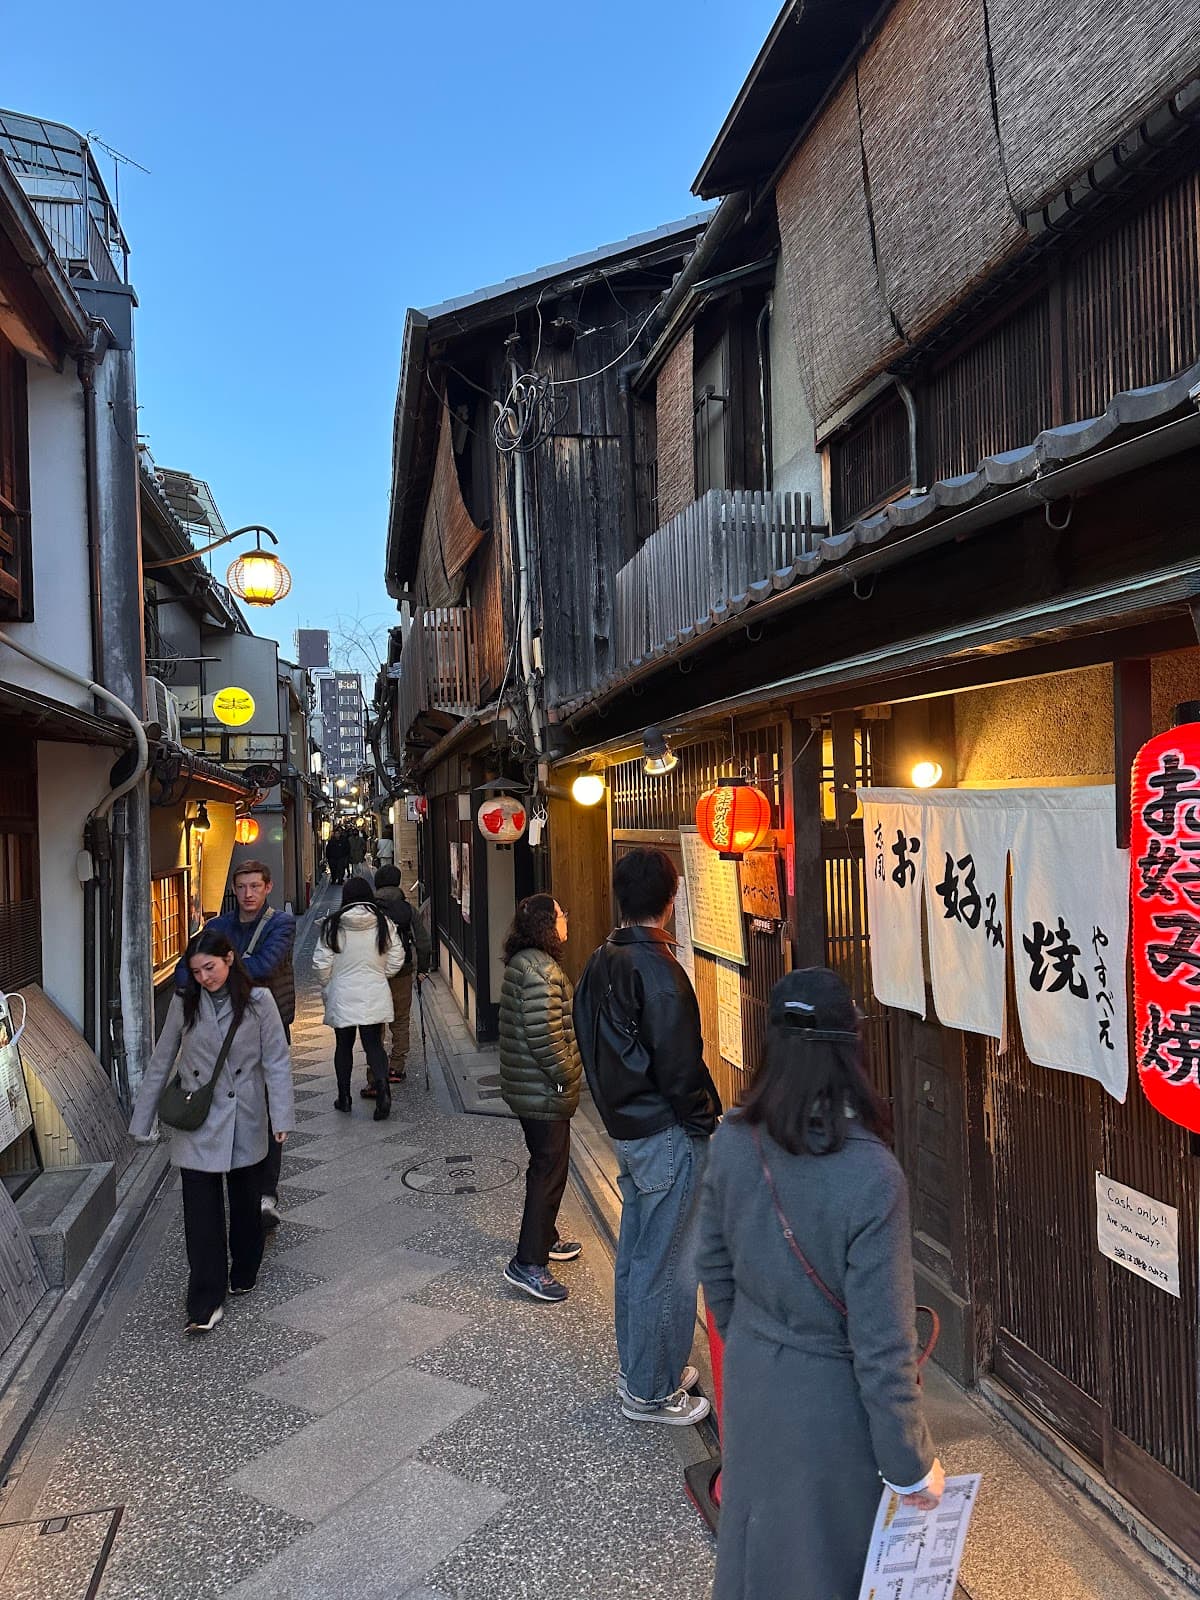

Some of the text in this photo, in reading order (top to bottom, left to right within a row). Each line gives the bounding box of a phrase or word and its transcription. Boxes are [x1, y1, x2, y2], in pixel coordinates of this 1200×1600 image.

[1092, 925, 1115, 1050] やすべえ
[1107, 1187, 1133, 1212] Cash
[1106, 1213, 1160, 1248] Are you ready?
